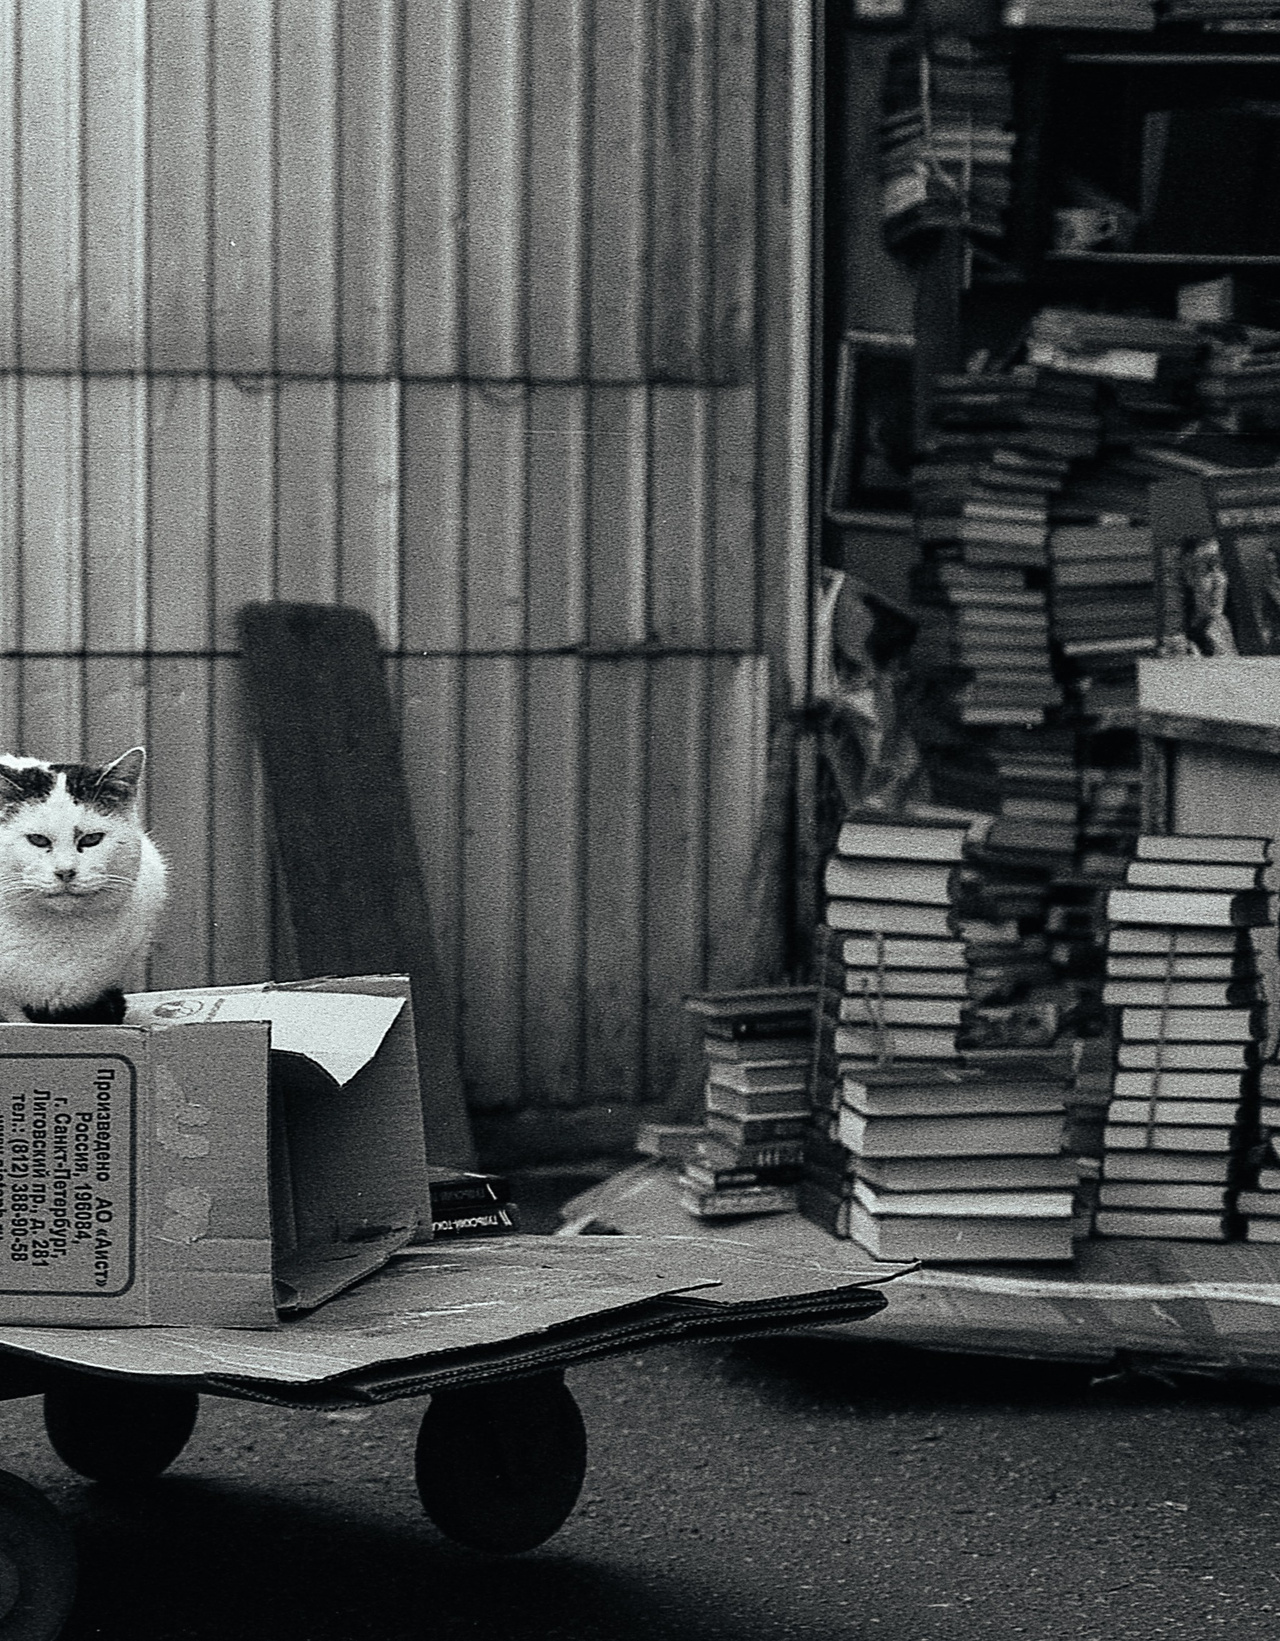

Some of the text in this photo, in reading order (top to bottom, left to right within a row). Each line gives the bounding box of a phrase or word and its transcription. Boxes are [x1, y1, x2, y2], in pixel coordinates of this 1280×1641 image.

[8, 1094, 28, 1261] тел.: (812) 388-90-58
[30, 1089, 50, 1267] Лиговский пр., д. 281
[49, 1097, 71, 1258] г. Санкт-Петербург,
[72, 1112, 92, 1244] Россия, 196084,
[93, 1069, 115, 1286] Произведено АО «Аист»
